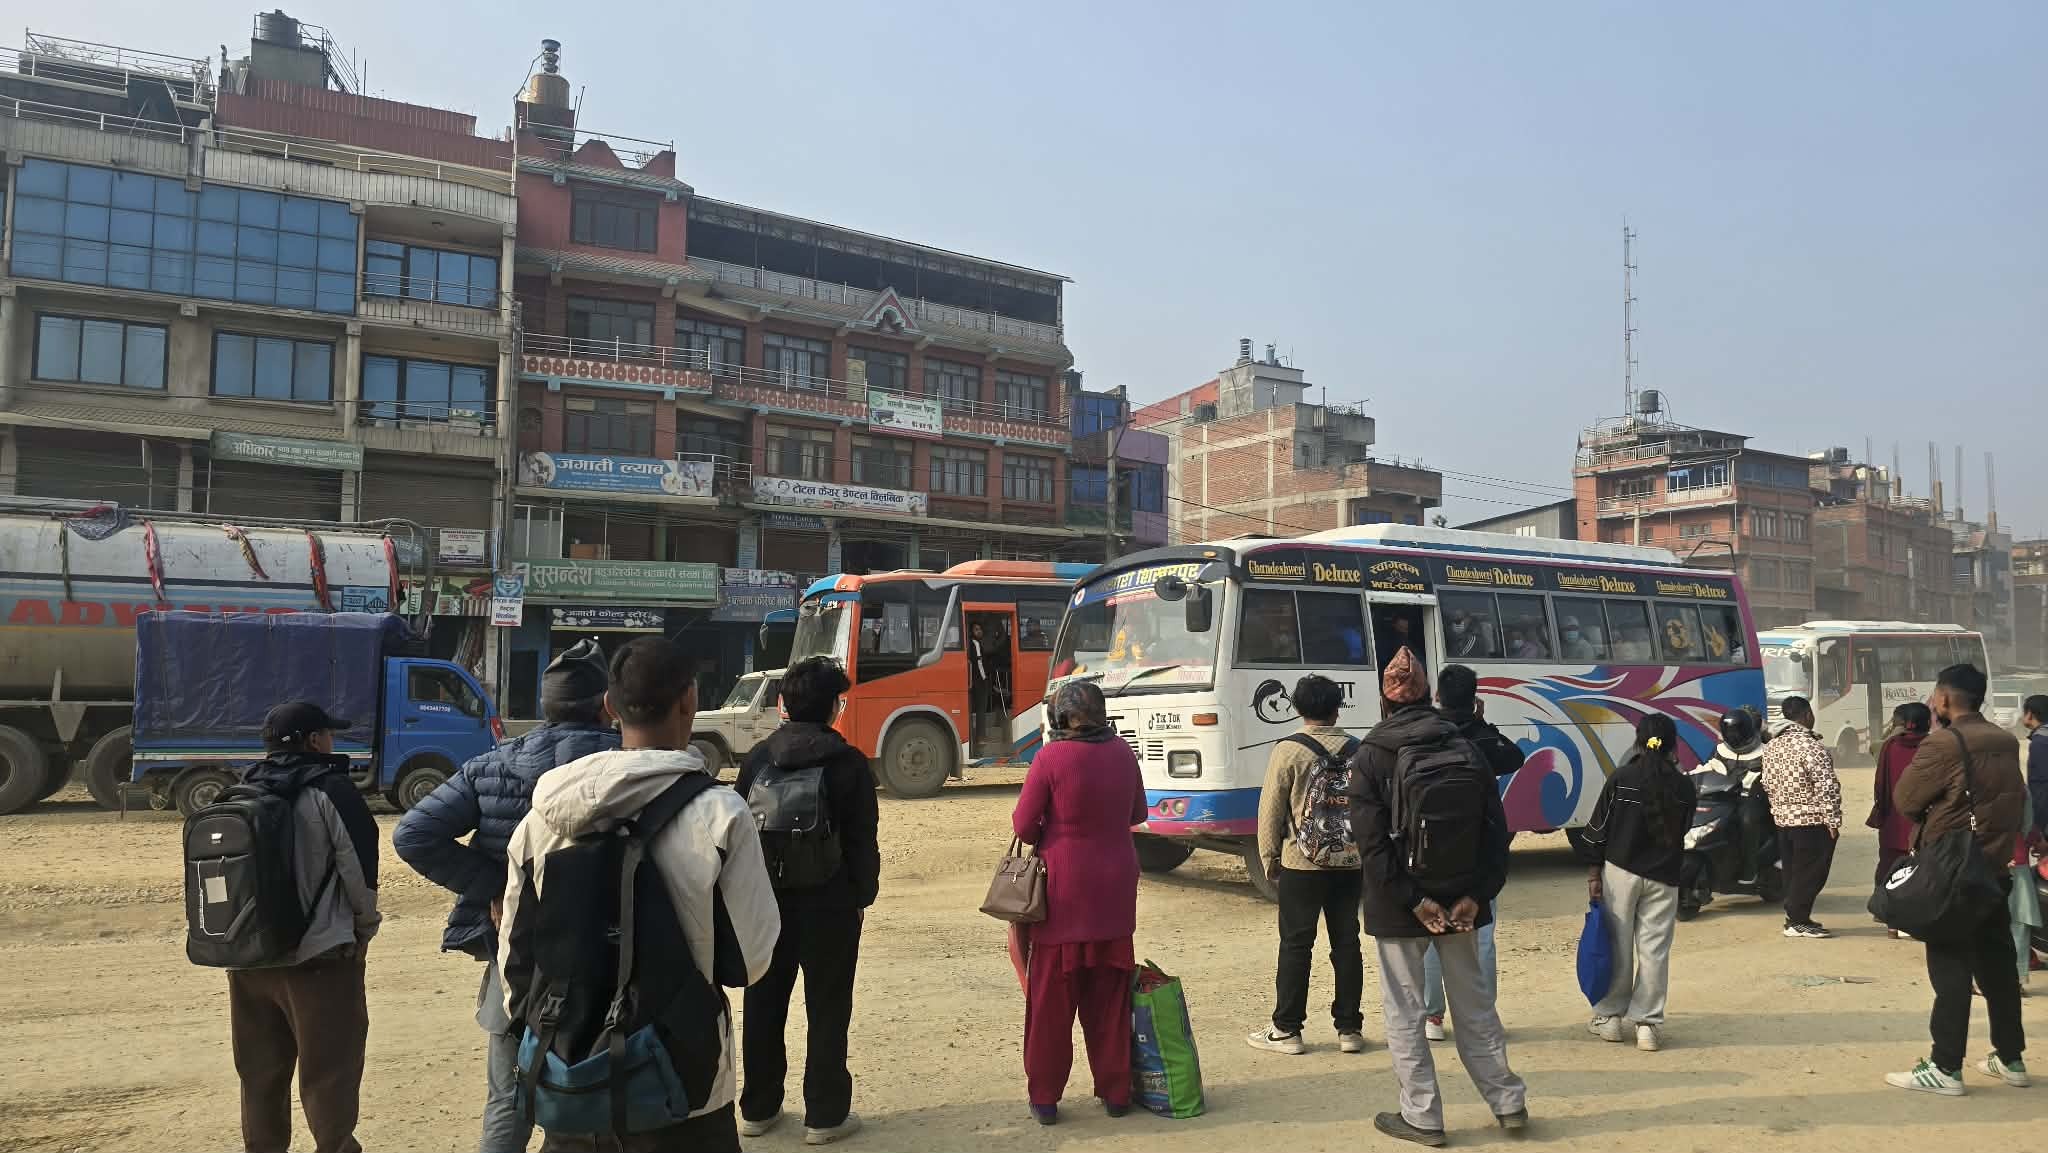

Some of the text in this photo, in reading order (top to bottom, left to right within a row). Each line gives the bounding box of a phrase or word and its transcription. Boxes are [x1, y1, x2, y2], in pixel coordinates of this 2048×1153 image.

[556, 455, 664, 475] जगाती ल्याब
[792, 482, 816, 495] टोटल
[532, 561, 592, 588] सुसन्देश
[1312, 562, 1361, 583] Deluxe
[1493, 567, 1534, 587] Deluxe
[1600, 575, 1637, 593] Deluxe
[1694, 583, 1728, 599] Deluxe
